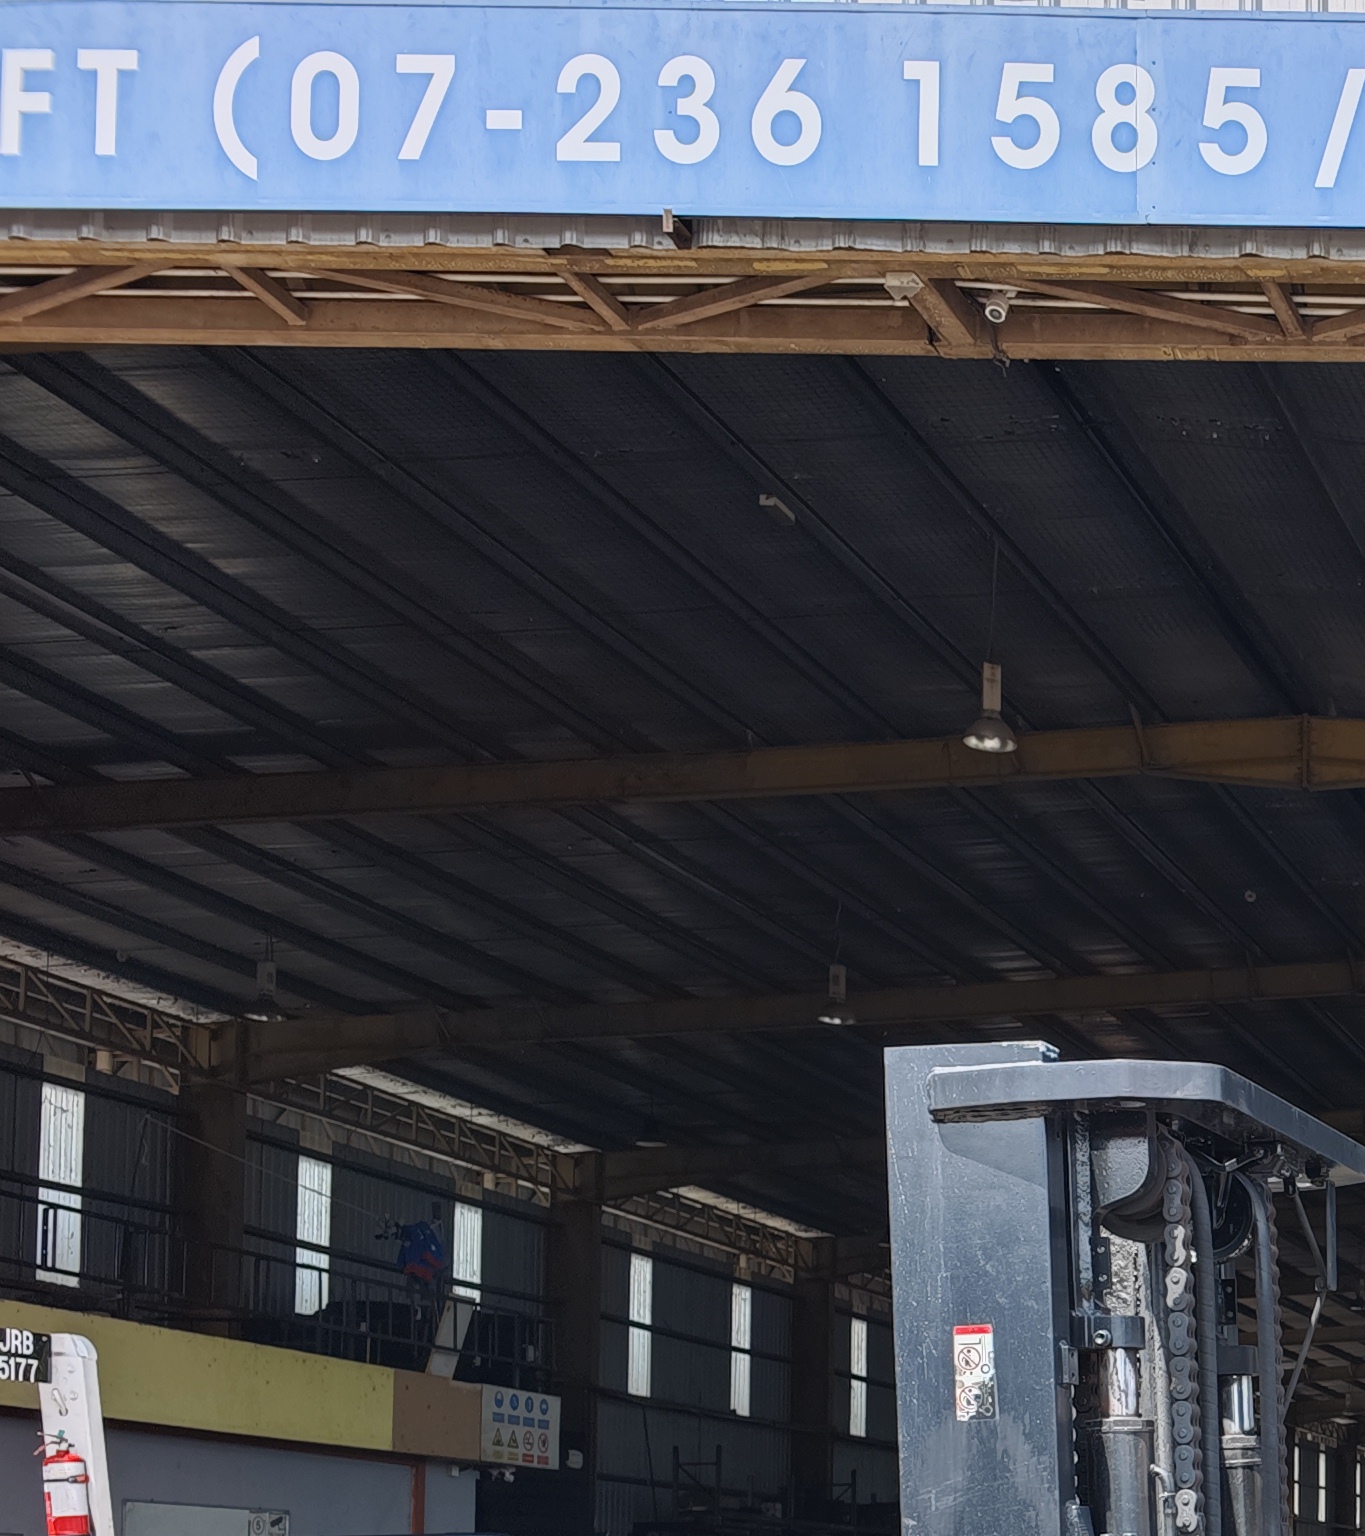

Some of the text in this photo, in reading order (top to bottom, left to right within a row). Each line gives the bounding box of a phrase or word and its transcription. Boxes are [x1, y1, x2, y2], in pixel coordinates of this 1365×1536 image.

[212, 36, 822, 181] (07-236
[0, 1328, 34, 1355] JRB
[0, 1356, 38, 1383] 5177
